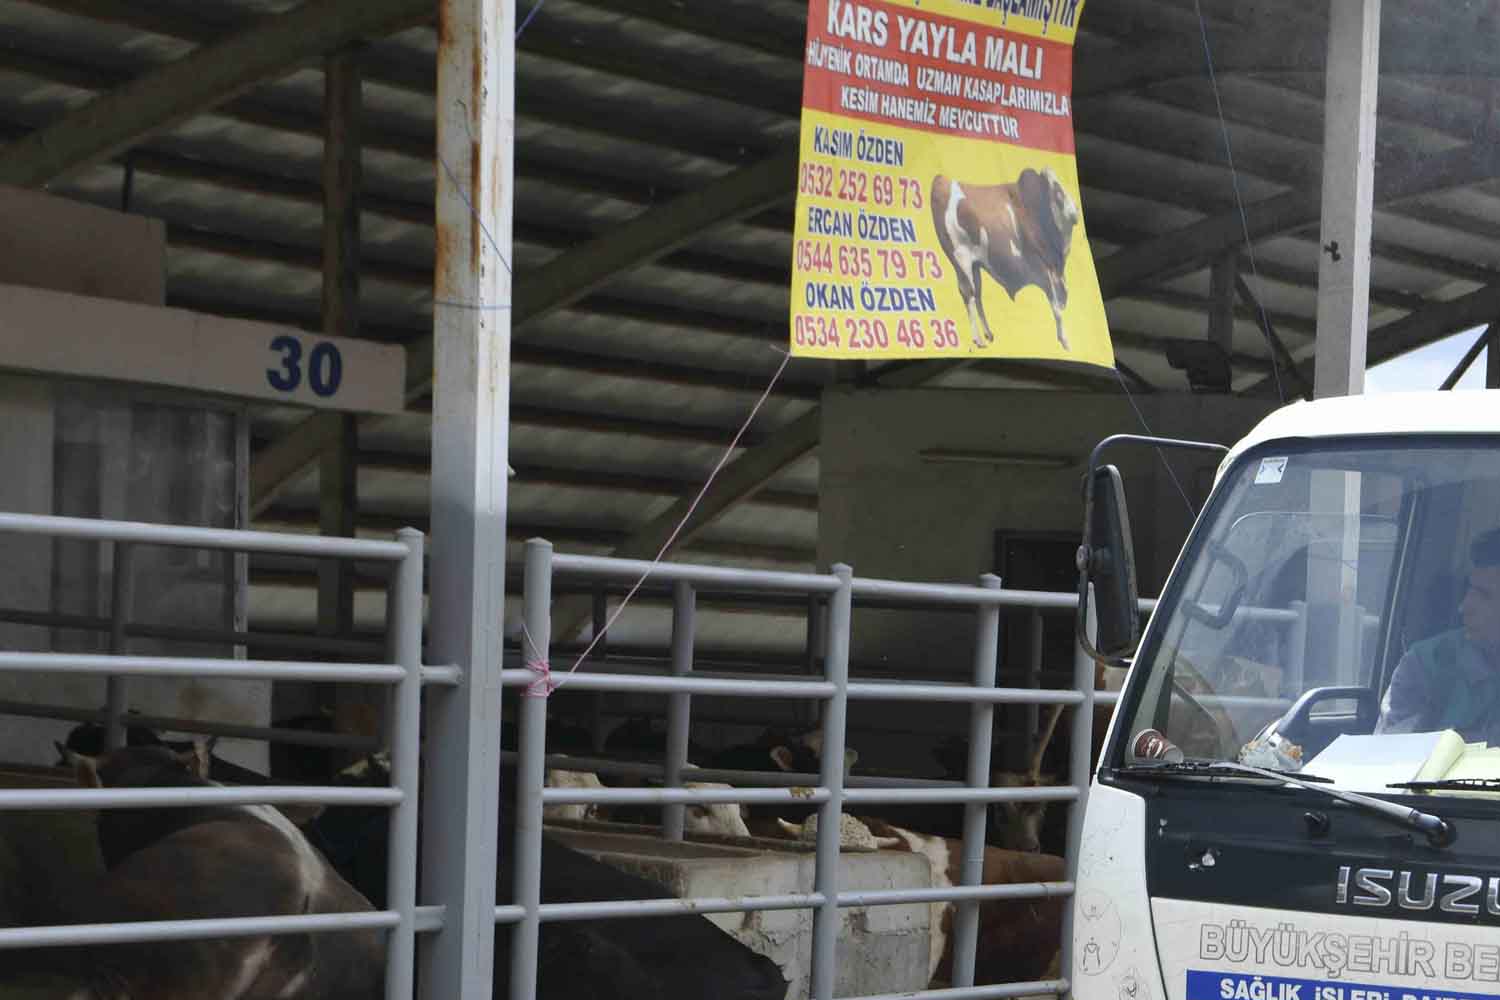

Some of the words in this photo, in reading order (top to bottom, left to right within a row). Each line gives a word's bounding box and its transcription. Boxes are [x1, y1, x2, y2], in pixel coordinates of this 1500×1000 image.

[827, 0, 888, 47] KARS
[896, 16, 977, 65] YAYLA
[984, 36, 1043, 80] MALI
[855, 53, 909, 86] ORTAMDA
[916, 66, 961, 94] UZMAN
[963, 77, 1071, 117] KASAPLARIMIZLA
[841, 83, 878, 113] KESİM
[881, 92, 936, 125] HANEMİZ
[939, 106, 1020, 138] MEVCUTTUR
[814, 125, 853, 158] KASIM
[856, 129, 904, 166] ÖZDEN
[799, 162, 833, 198] 0532
[838, 169, 868, 203] 252
[872, 174, 894, 206] 69
[899, 178, 923, 209] 73
[808, 206, 853, 239] ERCAN
[857, 208, 917, 243] ÖZDEN
[796, 239, 833, 273] 0544
[838, 245, 872, 277] 635
[876, 249, 907, 279] 79
[911, 250, 943, 279] 73
[805, 281, 855, 311] OKAN
[860, 281, 937, 312] ÖZDEN
[795, 315, 840, 347] 0534
[845, 318, 889, 349] 230
[896, 318, 925, 349] 46
[930, 318, 959, 348] 36
[266, 335, 343, 398] 30
[1199, 919, 1436, 978] BÜYÜKŞEHİR
